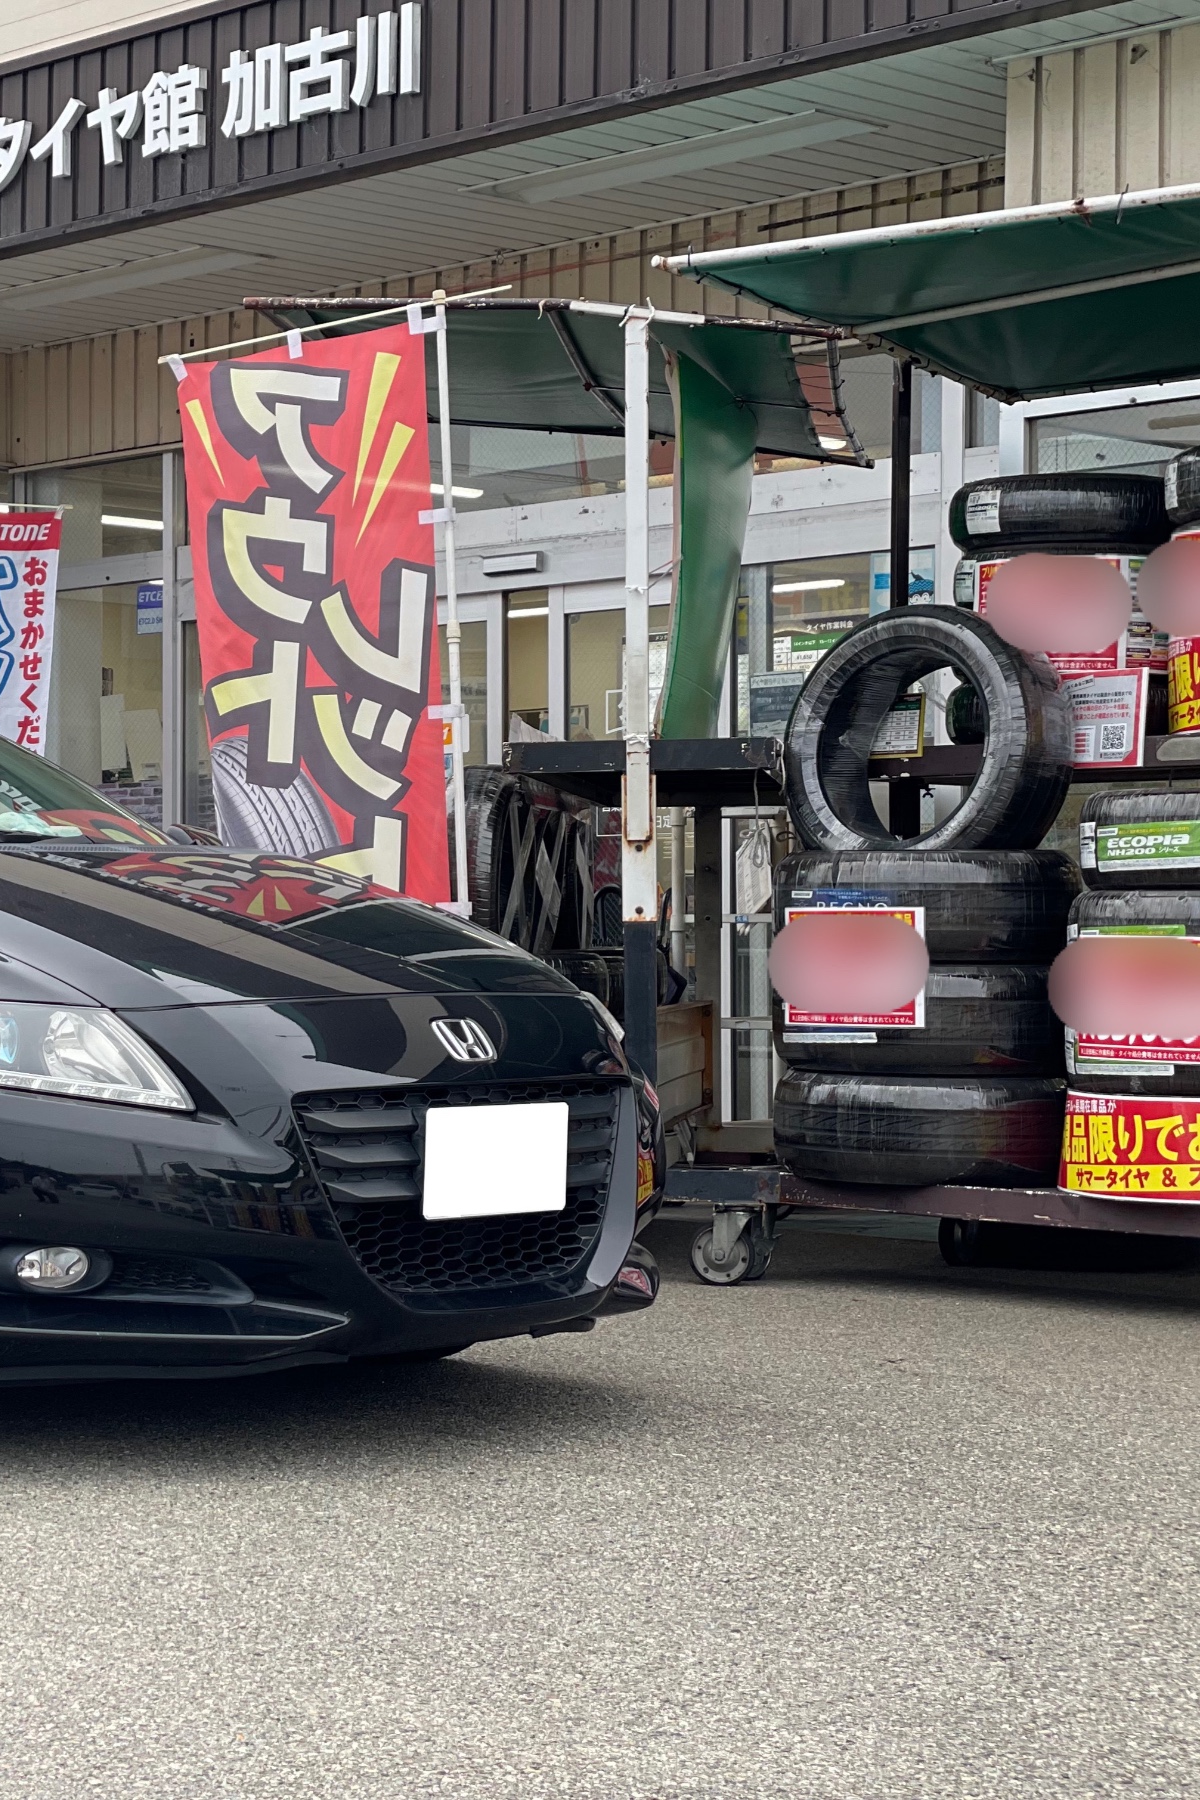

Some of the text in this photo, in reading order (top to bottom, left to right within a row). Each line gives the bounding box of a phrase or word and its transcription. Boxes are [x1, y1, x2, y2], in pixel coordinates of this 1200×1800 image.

[220, 2, 422, 139] 加古川
[15, 556, 49, 754] おまかせくだ
[1107, 847, 1156, 857] NH200
[1076, 1168, 1150, 1188] サマータイヤ
[1162, 1167, 1178, 1187] &
